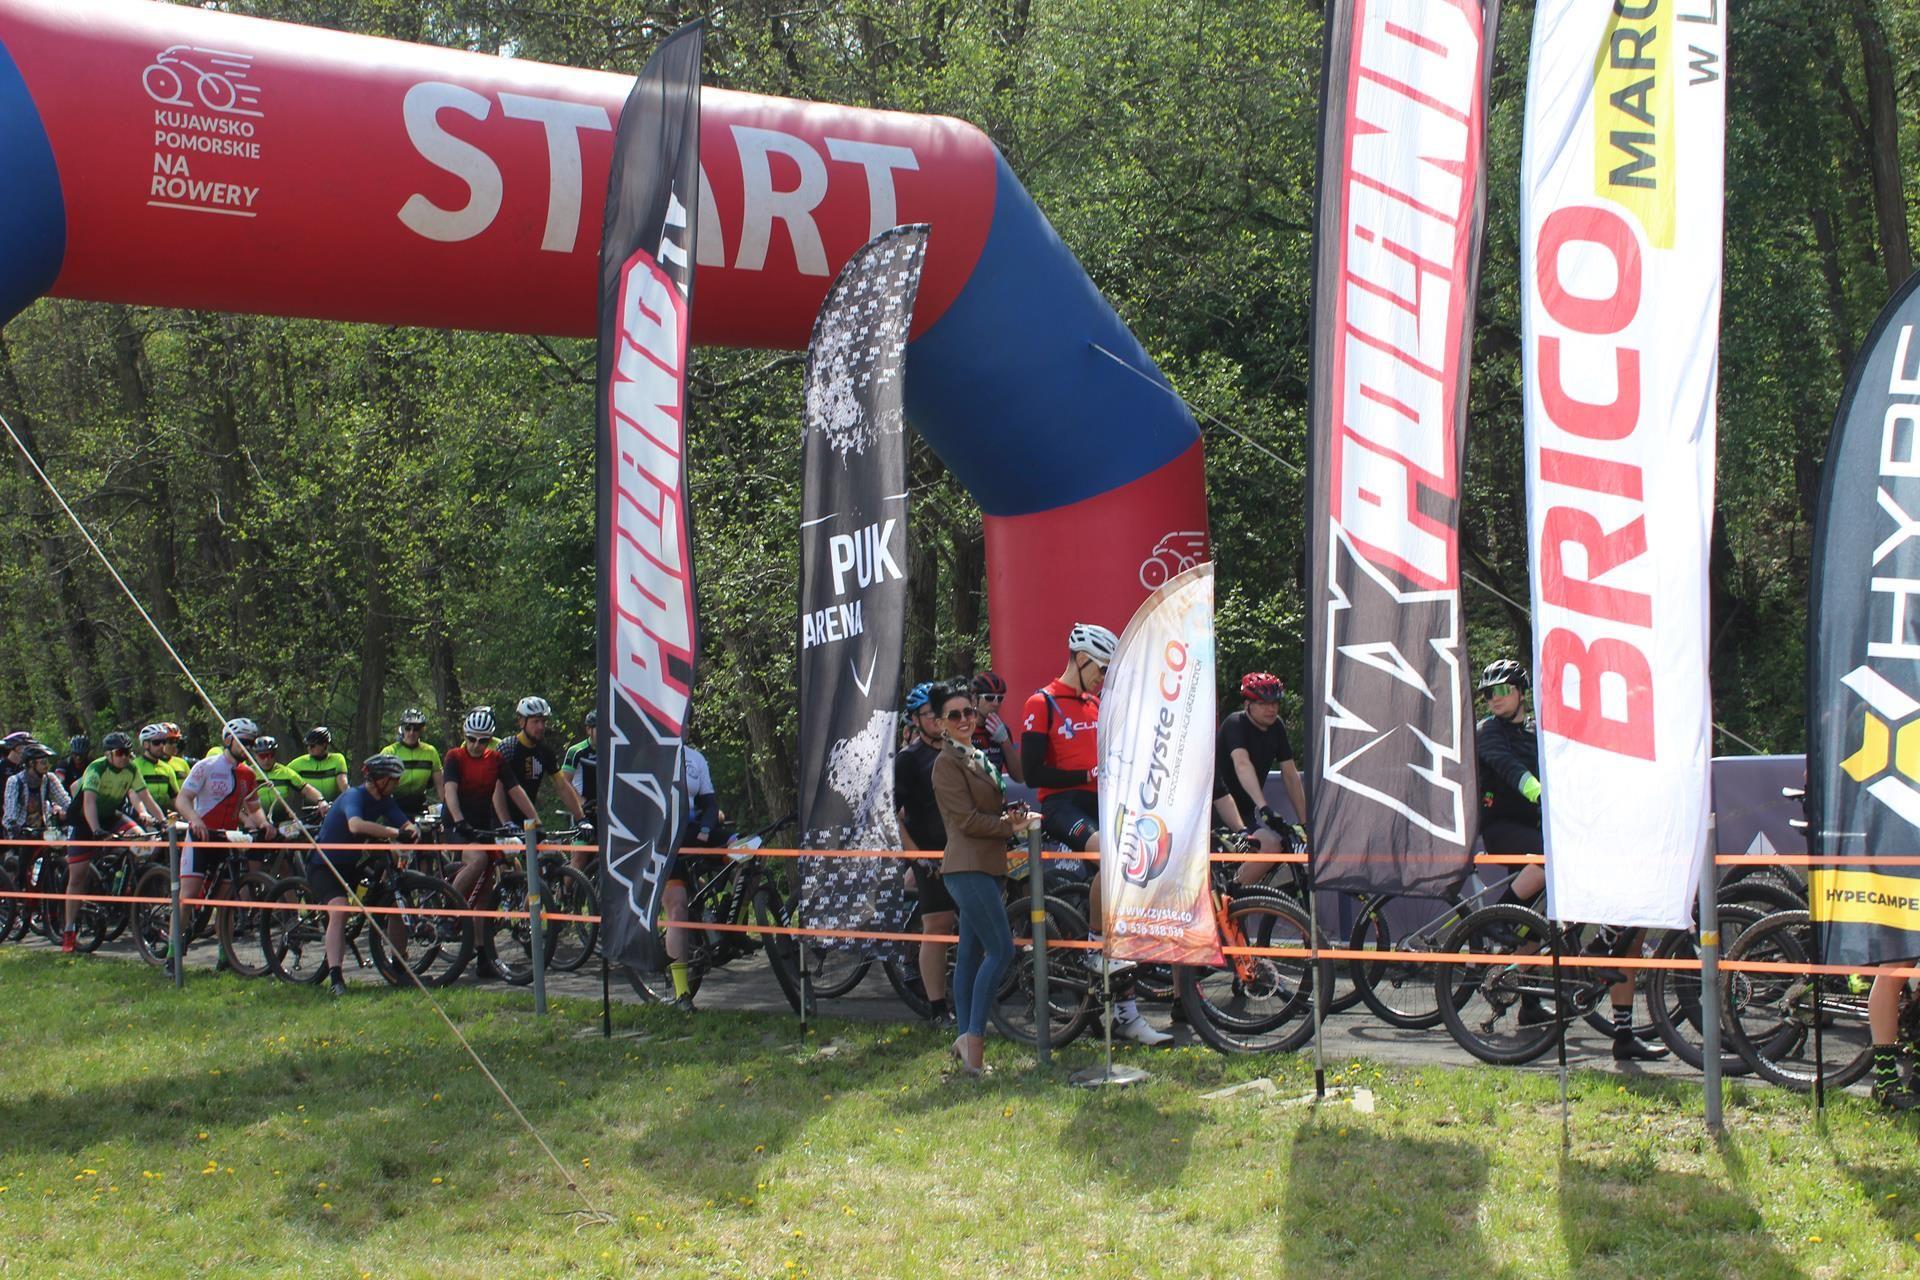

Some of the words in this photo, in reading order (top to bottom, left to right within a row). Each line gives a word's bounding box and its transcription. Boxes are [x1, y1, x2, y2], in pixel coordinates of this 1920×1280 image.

[154, 109, 255, 138] KUJAWSKO
[153, 152, 190, 177] NA
[154, 130, 261, 159] POMORSKIE
[150, 175, 260, 207] ROWERY
[397, 81, 920, 277] STRT
[1537, 205, 1657, 762] BRICO
[829, 518, 903, 596] PUK
[803, 600, 864, 650] ARENA
[1139, 706, 1175, 810] Czyste
[1159, 639, 1190, 703] C.O.
[1825, 888, 1920, 911] HYPECAMPE
